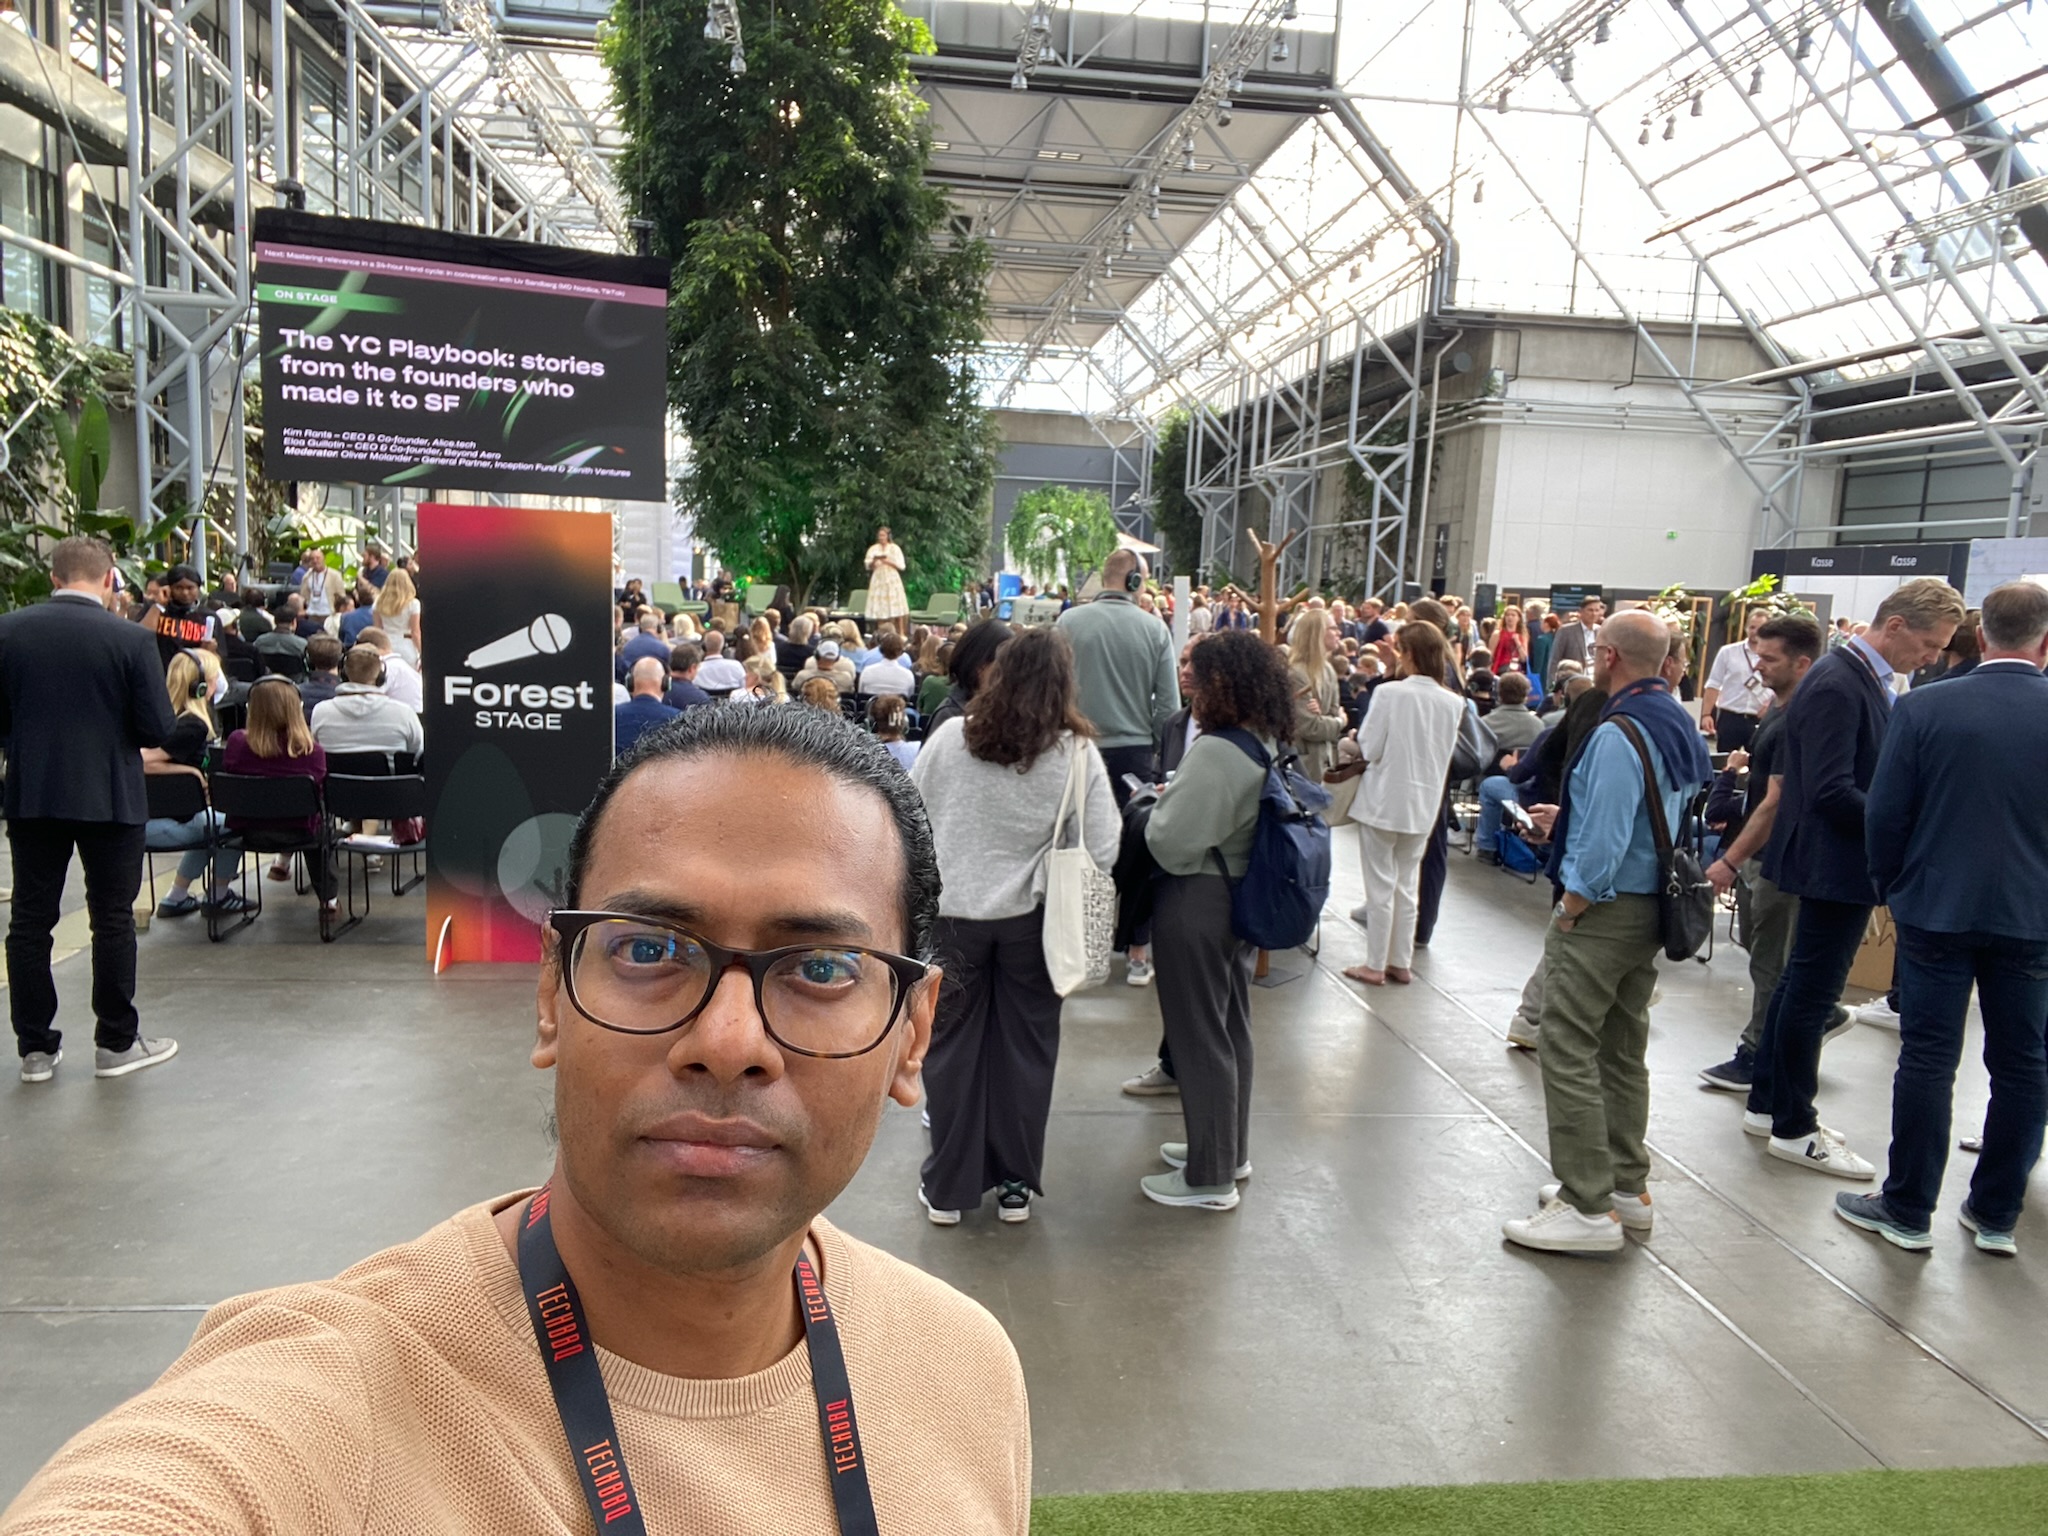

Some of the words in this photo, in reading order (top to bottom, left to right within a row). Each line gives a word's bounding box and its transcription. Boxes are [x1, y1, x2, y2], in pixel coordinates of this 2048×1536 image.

[264, 249, 285, 258] Next:
[286, 251, 323, 263] Mastering
[324, 256, 360, 266] relevance
[454, 270, 498, 281] conversation
[274, 289, 294, 299] ON
[296, 292, 338, 304] STAGE
[278, 328, 334, 351] The
[339, 333, 382, 355] YC
[388, 338, 516, 369] Playbook:
[520, 353, 605, 377] stories
[279, 354, 346, 379] from
[351, 361, 397, 382] the
[401, 364, 518, 393] founders
[522, 378, 575, 398] who
[281, 384, 360, 405] made
[366, 387, 384, 407] it
[389, 390, 418, 410] to
[423, 392, 461, 413] SF
[283, 427, 302, 437] Kim
[341, 431, 366, 441] CEO
[367, 432, 376, 442] &
[377, 433, 431, 447] Co-founder,
[354, 441, 379, 451] CEO
[379, 443, 388, 452] &
[389, 444, 443, 456] Co-founder,
[443, 447, 479, 459] Beyond
[479, 450, 502, 460] Aero
[340, 449, 368, 460] Oliver
[369, 451, 413, 463] Molander
[420, 455, 458, 466] General
[458, 457, 494, 469] Partner,
[494, 460, 534, 472] Inception
[534, 463, 557, 473] Fund
[594, 467, 632, 478] Ventures
[1811, 556, 1835, 568] Kasse
[1890, 555, 1918, 567] Kasse
[444, 675, 594, 710] Forest
[475, 710, 562, 730] STAGE
[536, 1282, 584, 1362] TECHBBQ
[825, 1398, 858, 1475] TECHBBQ
[583, 1438, 632, 1525] TECHBBQ
